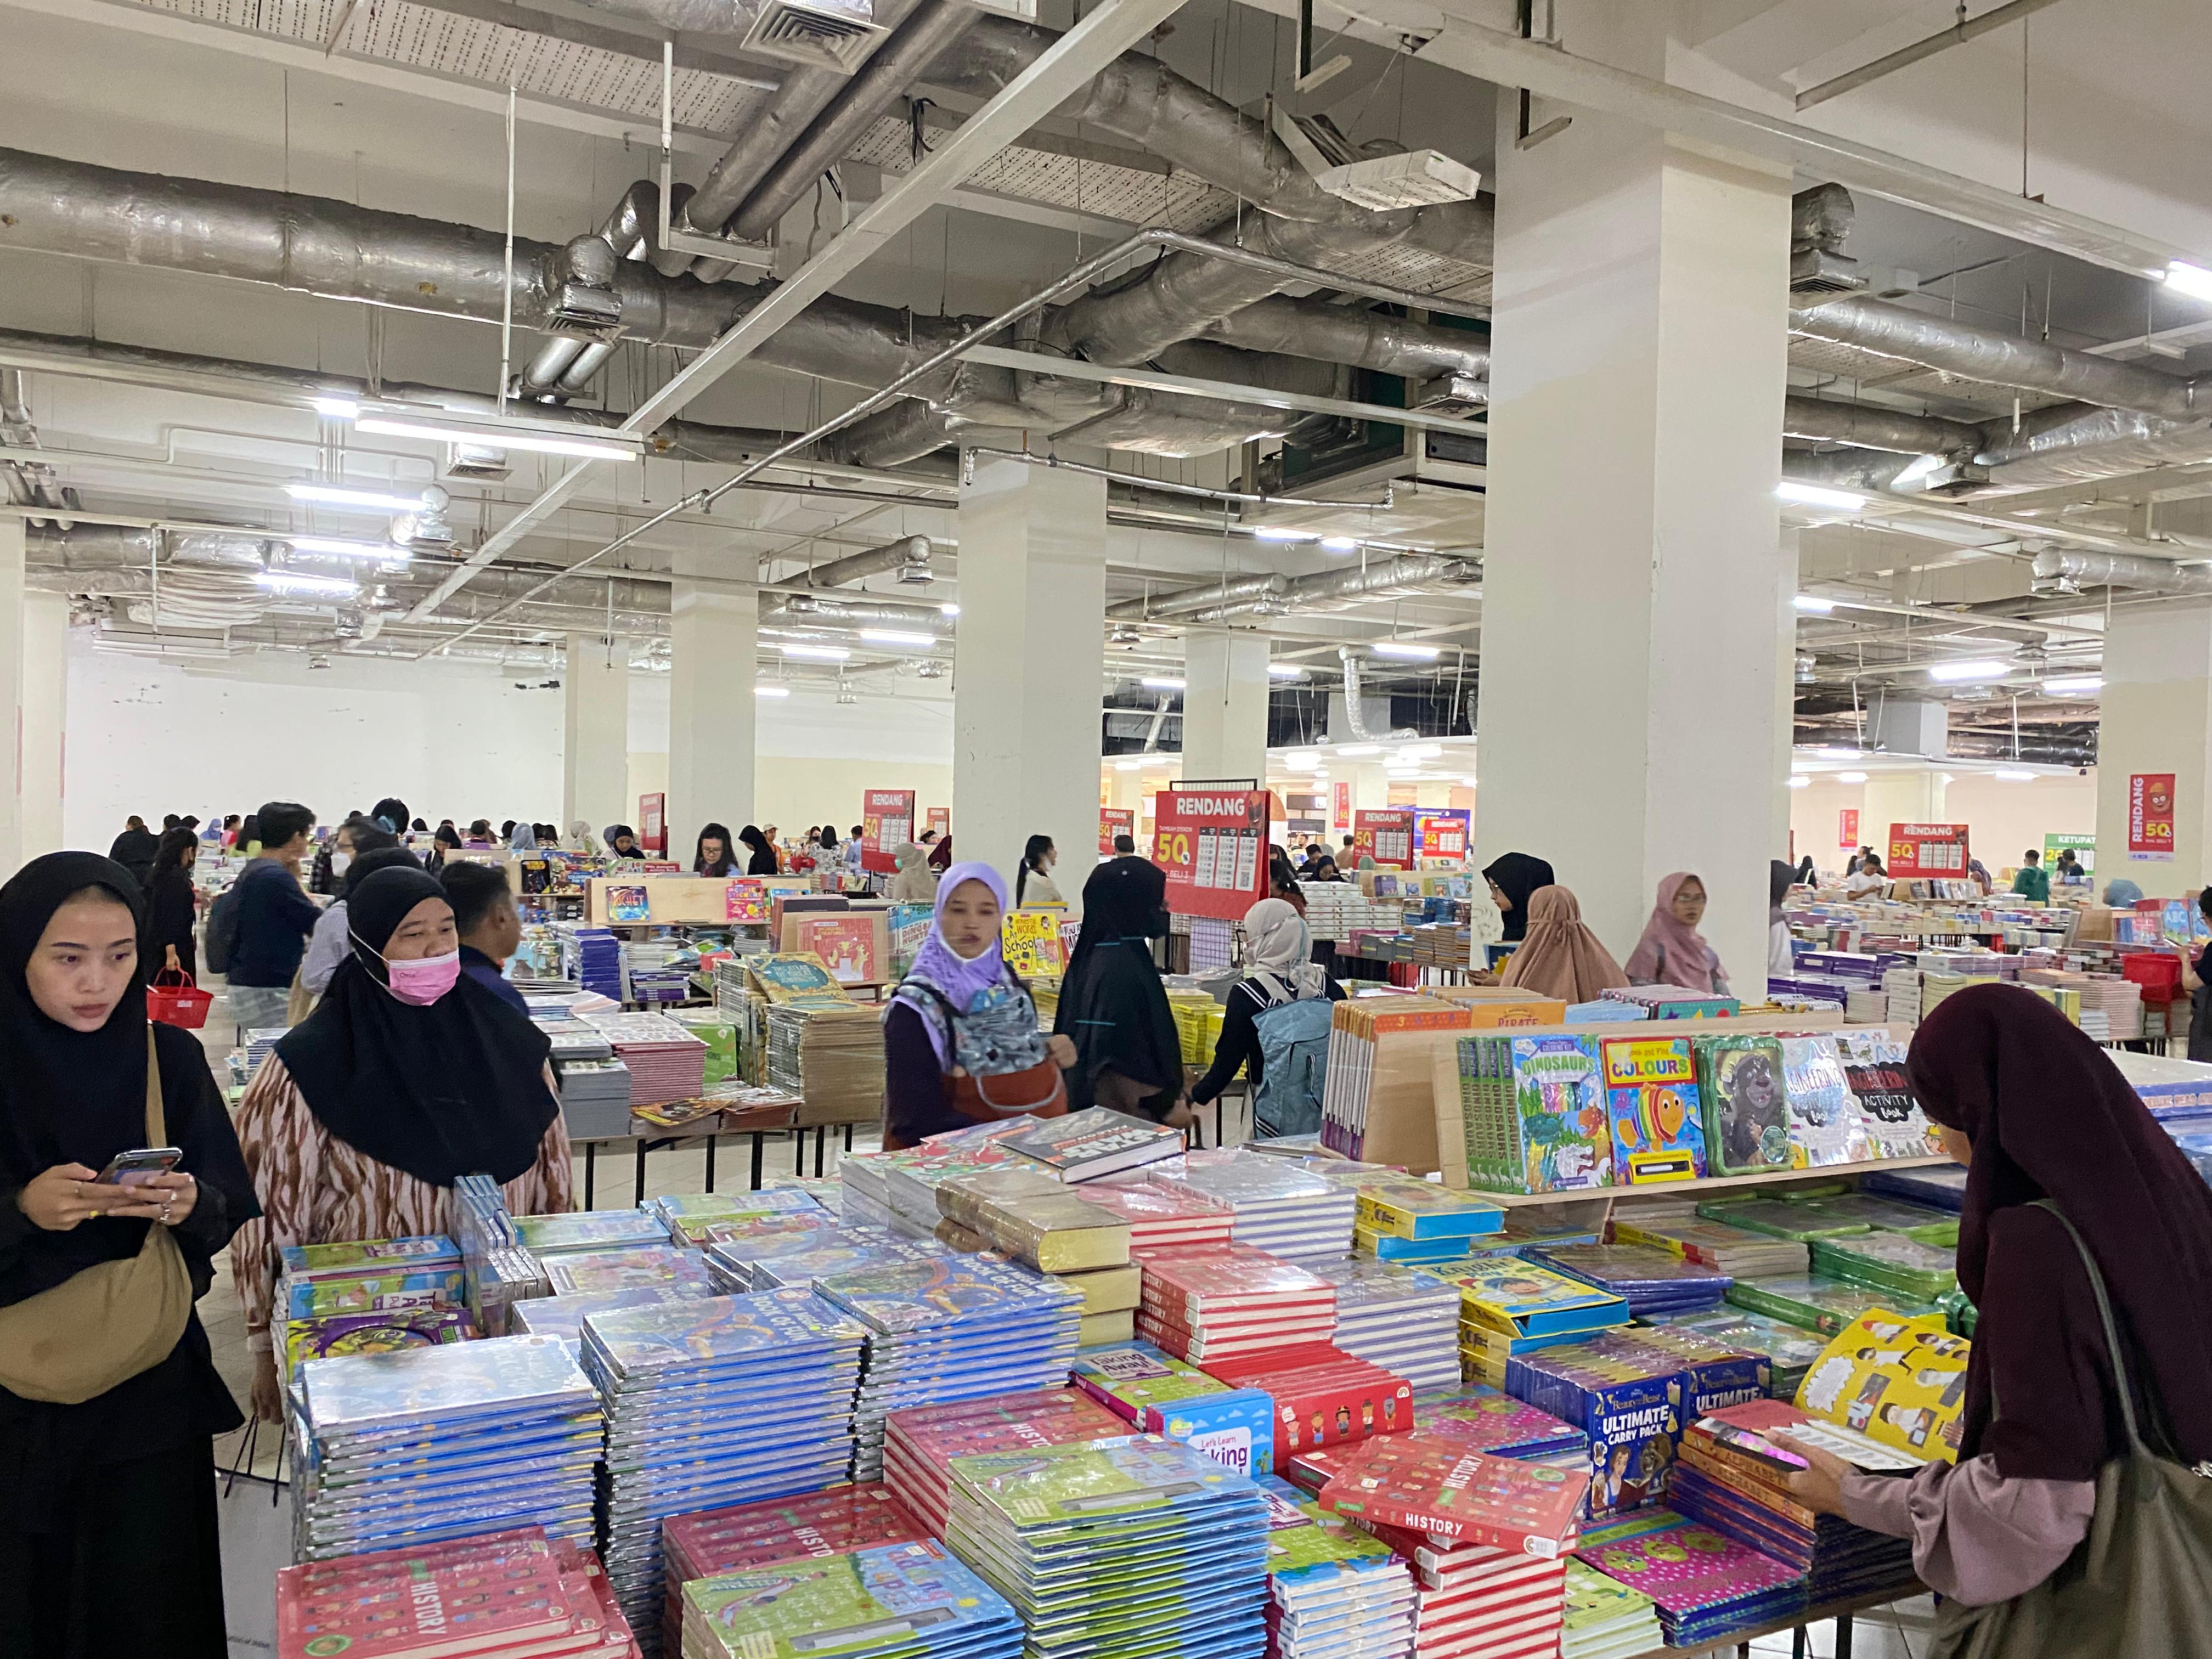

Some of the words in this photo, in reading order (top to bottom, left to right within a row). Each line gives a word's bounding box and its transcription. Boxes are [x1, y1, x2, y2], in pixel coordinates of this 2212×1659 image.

[872, 794, 902, 806] RENDANG
[1177, 798, 1245, 816] RENDANG
[1365, 813, 1401, 822] RENDANG
[2132, 777, 2144, 842] RENDANG
[1904, 826, 1953, 836] RENDANG
[2166, 910, 2186, 922] ABC
[1005, 936, 1036, 953] School
[1398, 1016, 1404, 1027] 3
[1521, 1055, 1595, 1076] DINOSAURS
[1612, 1058, 1689, 1077] COLOURS
[1864, 1094, 1908, 1107] ACTIVITY
[955, 1258, 999, 1276] BOOK
[1429, 1261, 1513, 1276] Knight
[990, 1276, 1017, 1284] OF
[1003, 1284, 1041, 1297] FUN
[1142, 1287, 1163, 1304] ISTORY
[747, 1296, 785, 1317] BOOK
[770, 1317, 797, 1326] OF
[778, 1325, 814, 1341] FUN
[1090, 1354, 1147, 1365] Taking
[1102, 1361, 1153, 1371] Away!
[1696, 1386, 1760, 1412] ULTIMATE
[1602, 1404, 1670, 1435] ULTIMATE
[1009, 1423, 1053, 1448] HISTO
[1201, 1437, 1216, 1448] Let's
[1218, 1435, 1237, 1445] Learn
[1608, 1430, 1637, 1446] CARRY
[1639, 1423, 1663, 1438] PACK
[1200, 1447, 1248, 1468] king
[1442, 1454, 1483, 1489] HISTORY
[1406, 1513, 1463, 1536] HISTORY
[792, 1527, 834, 1558] HISTO
[410, 1582, 448, 1634] HISTORY
